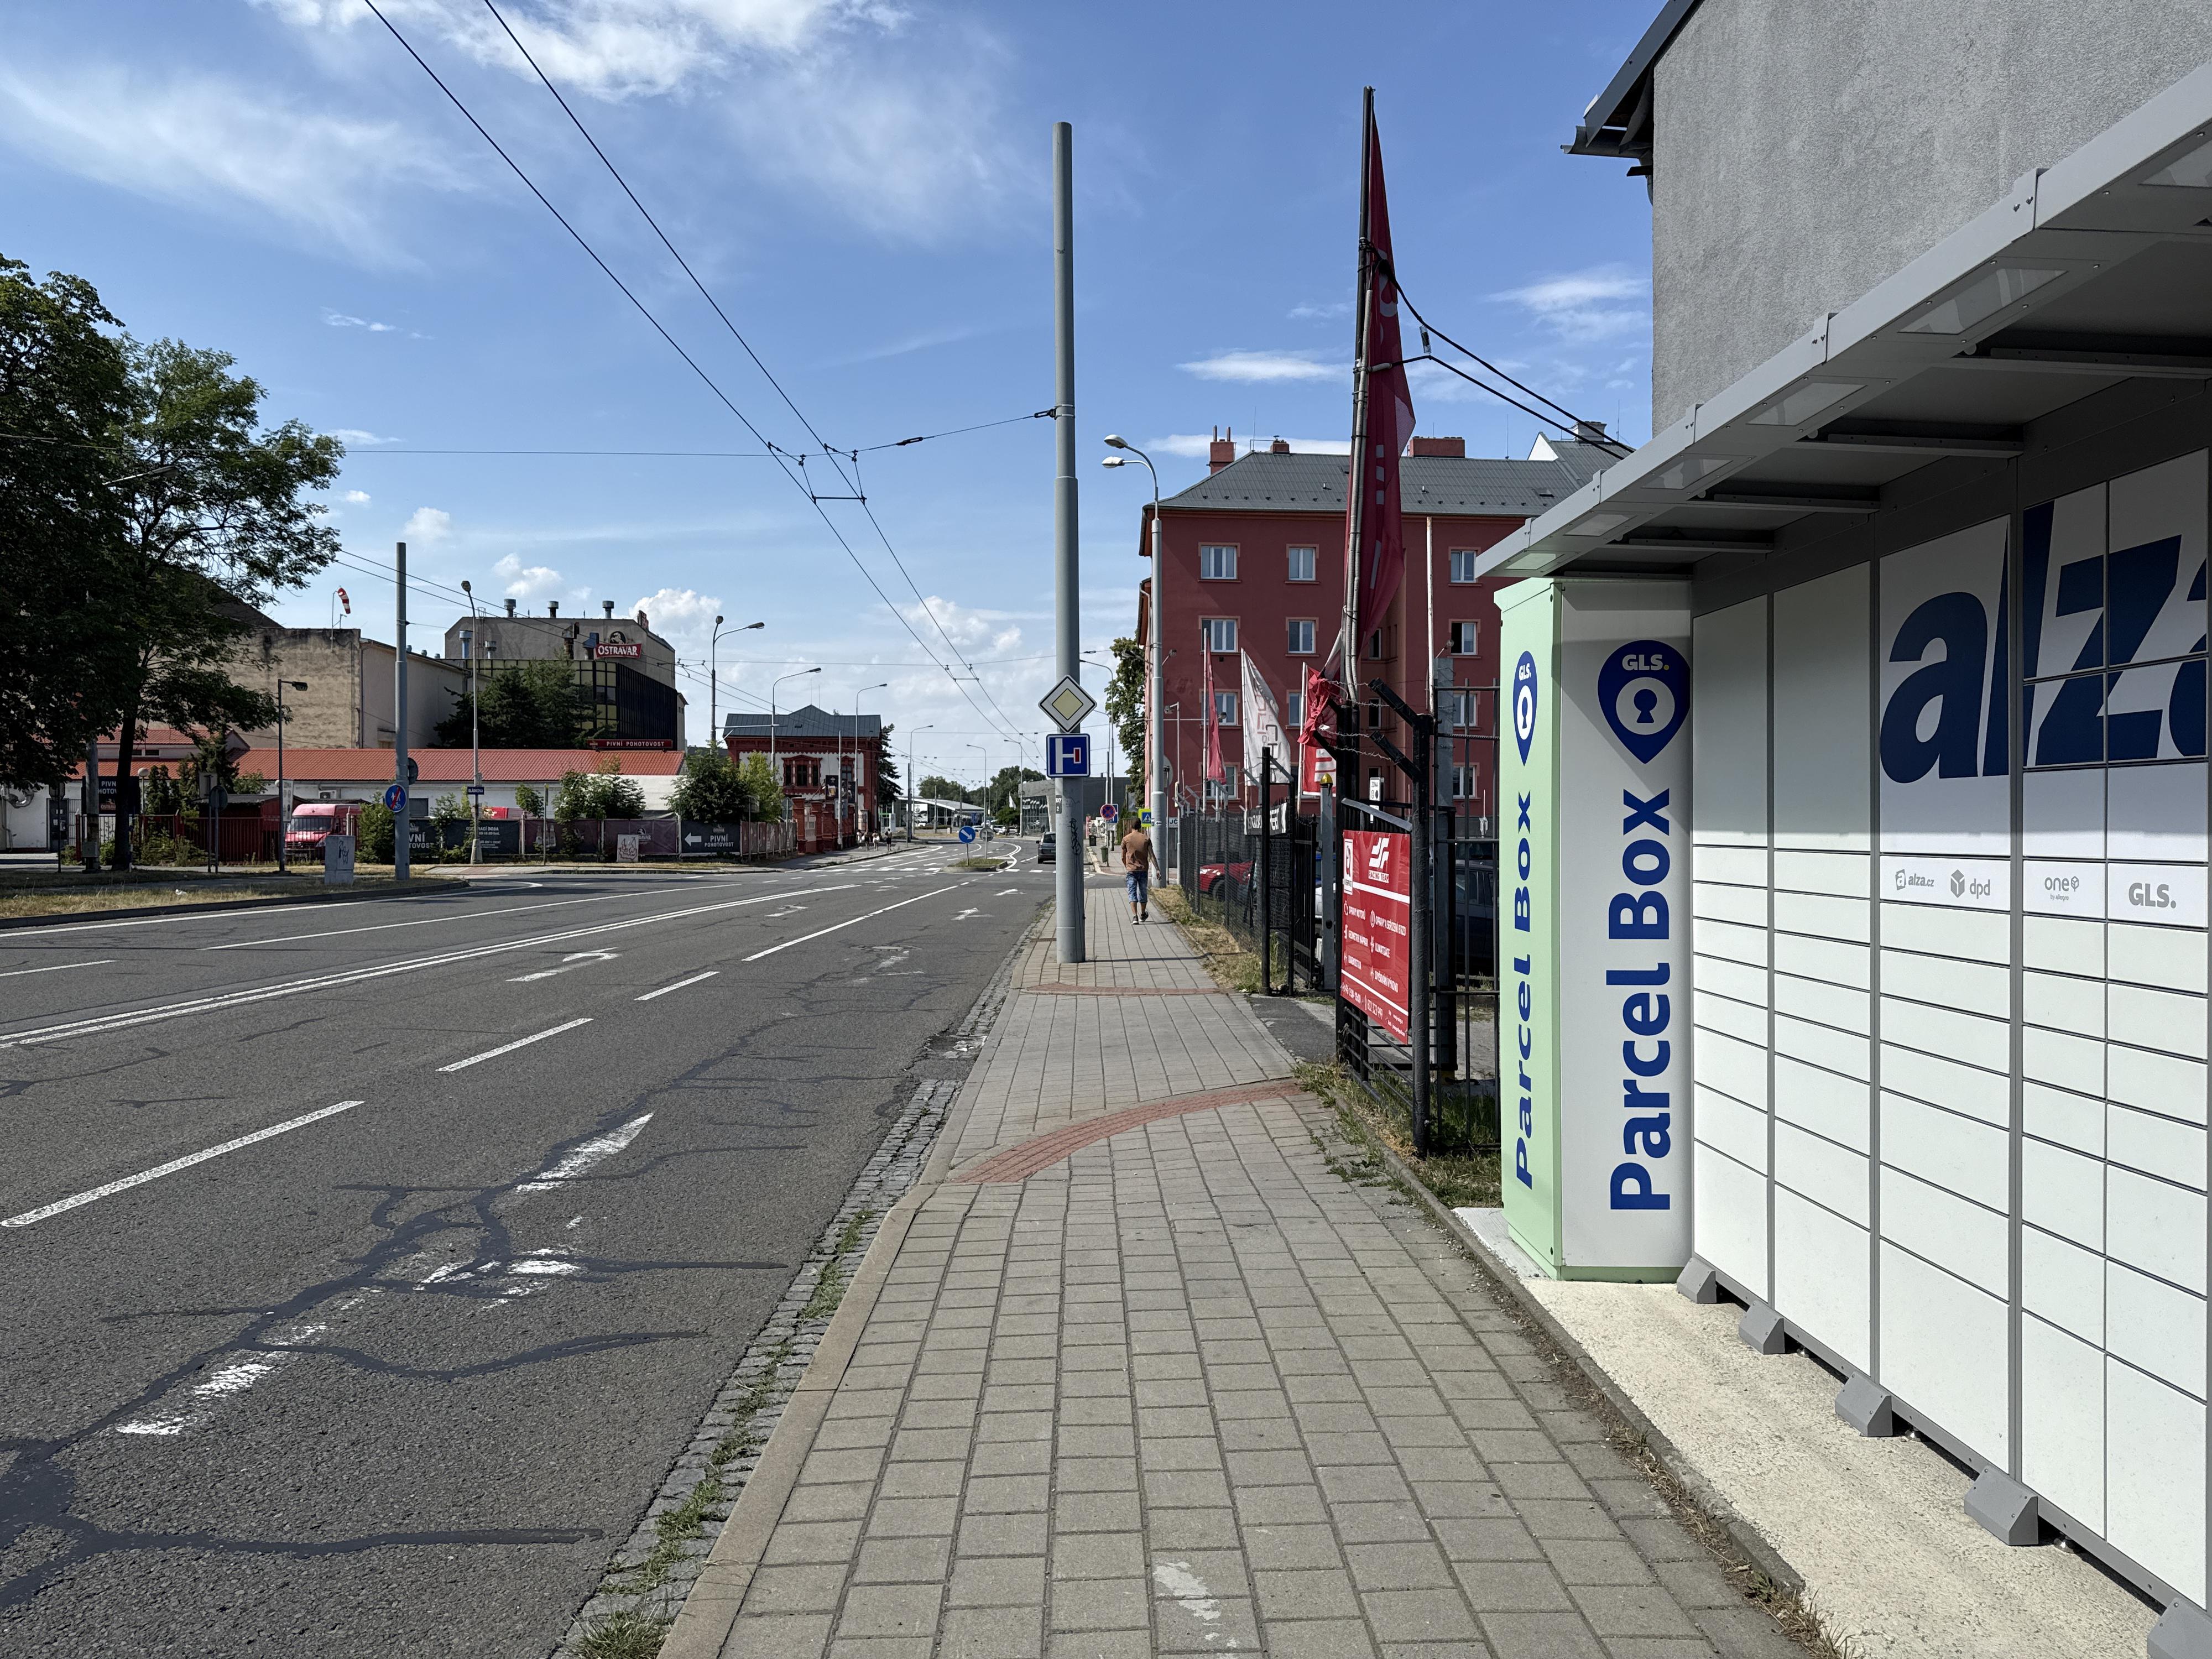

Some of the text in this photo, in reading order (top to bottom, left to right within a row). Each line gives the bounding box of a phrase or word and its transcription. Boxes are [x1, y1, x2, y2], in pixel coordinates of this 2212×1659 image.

[598, 645, 638, 656] OSTRAVAR
[710, 833, 728, 842] PIVNÍ
[1380, 873, 1389, 882] TEAM
[1908, 873, 1934, 887] alza.cz
[2044, 877, 2069, 891] one
[1969, 878, 1990, 899] dpd
[2128, 882, 2177, 909] GLS.
[1514, 790, 1532, 1189] Parcel Box
[1606, 788, 1671, 1209] Parcel Box
